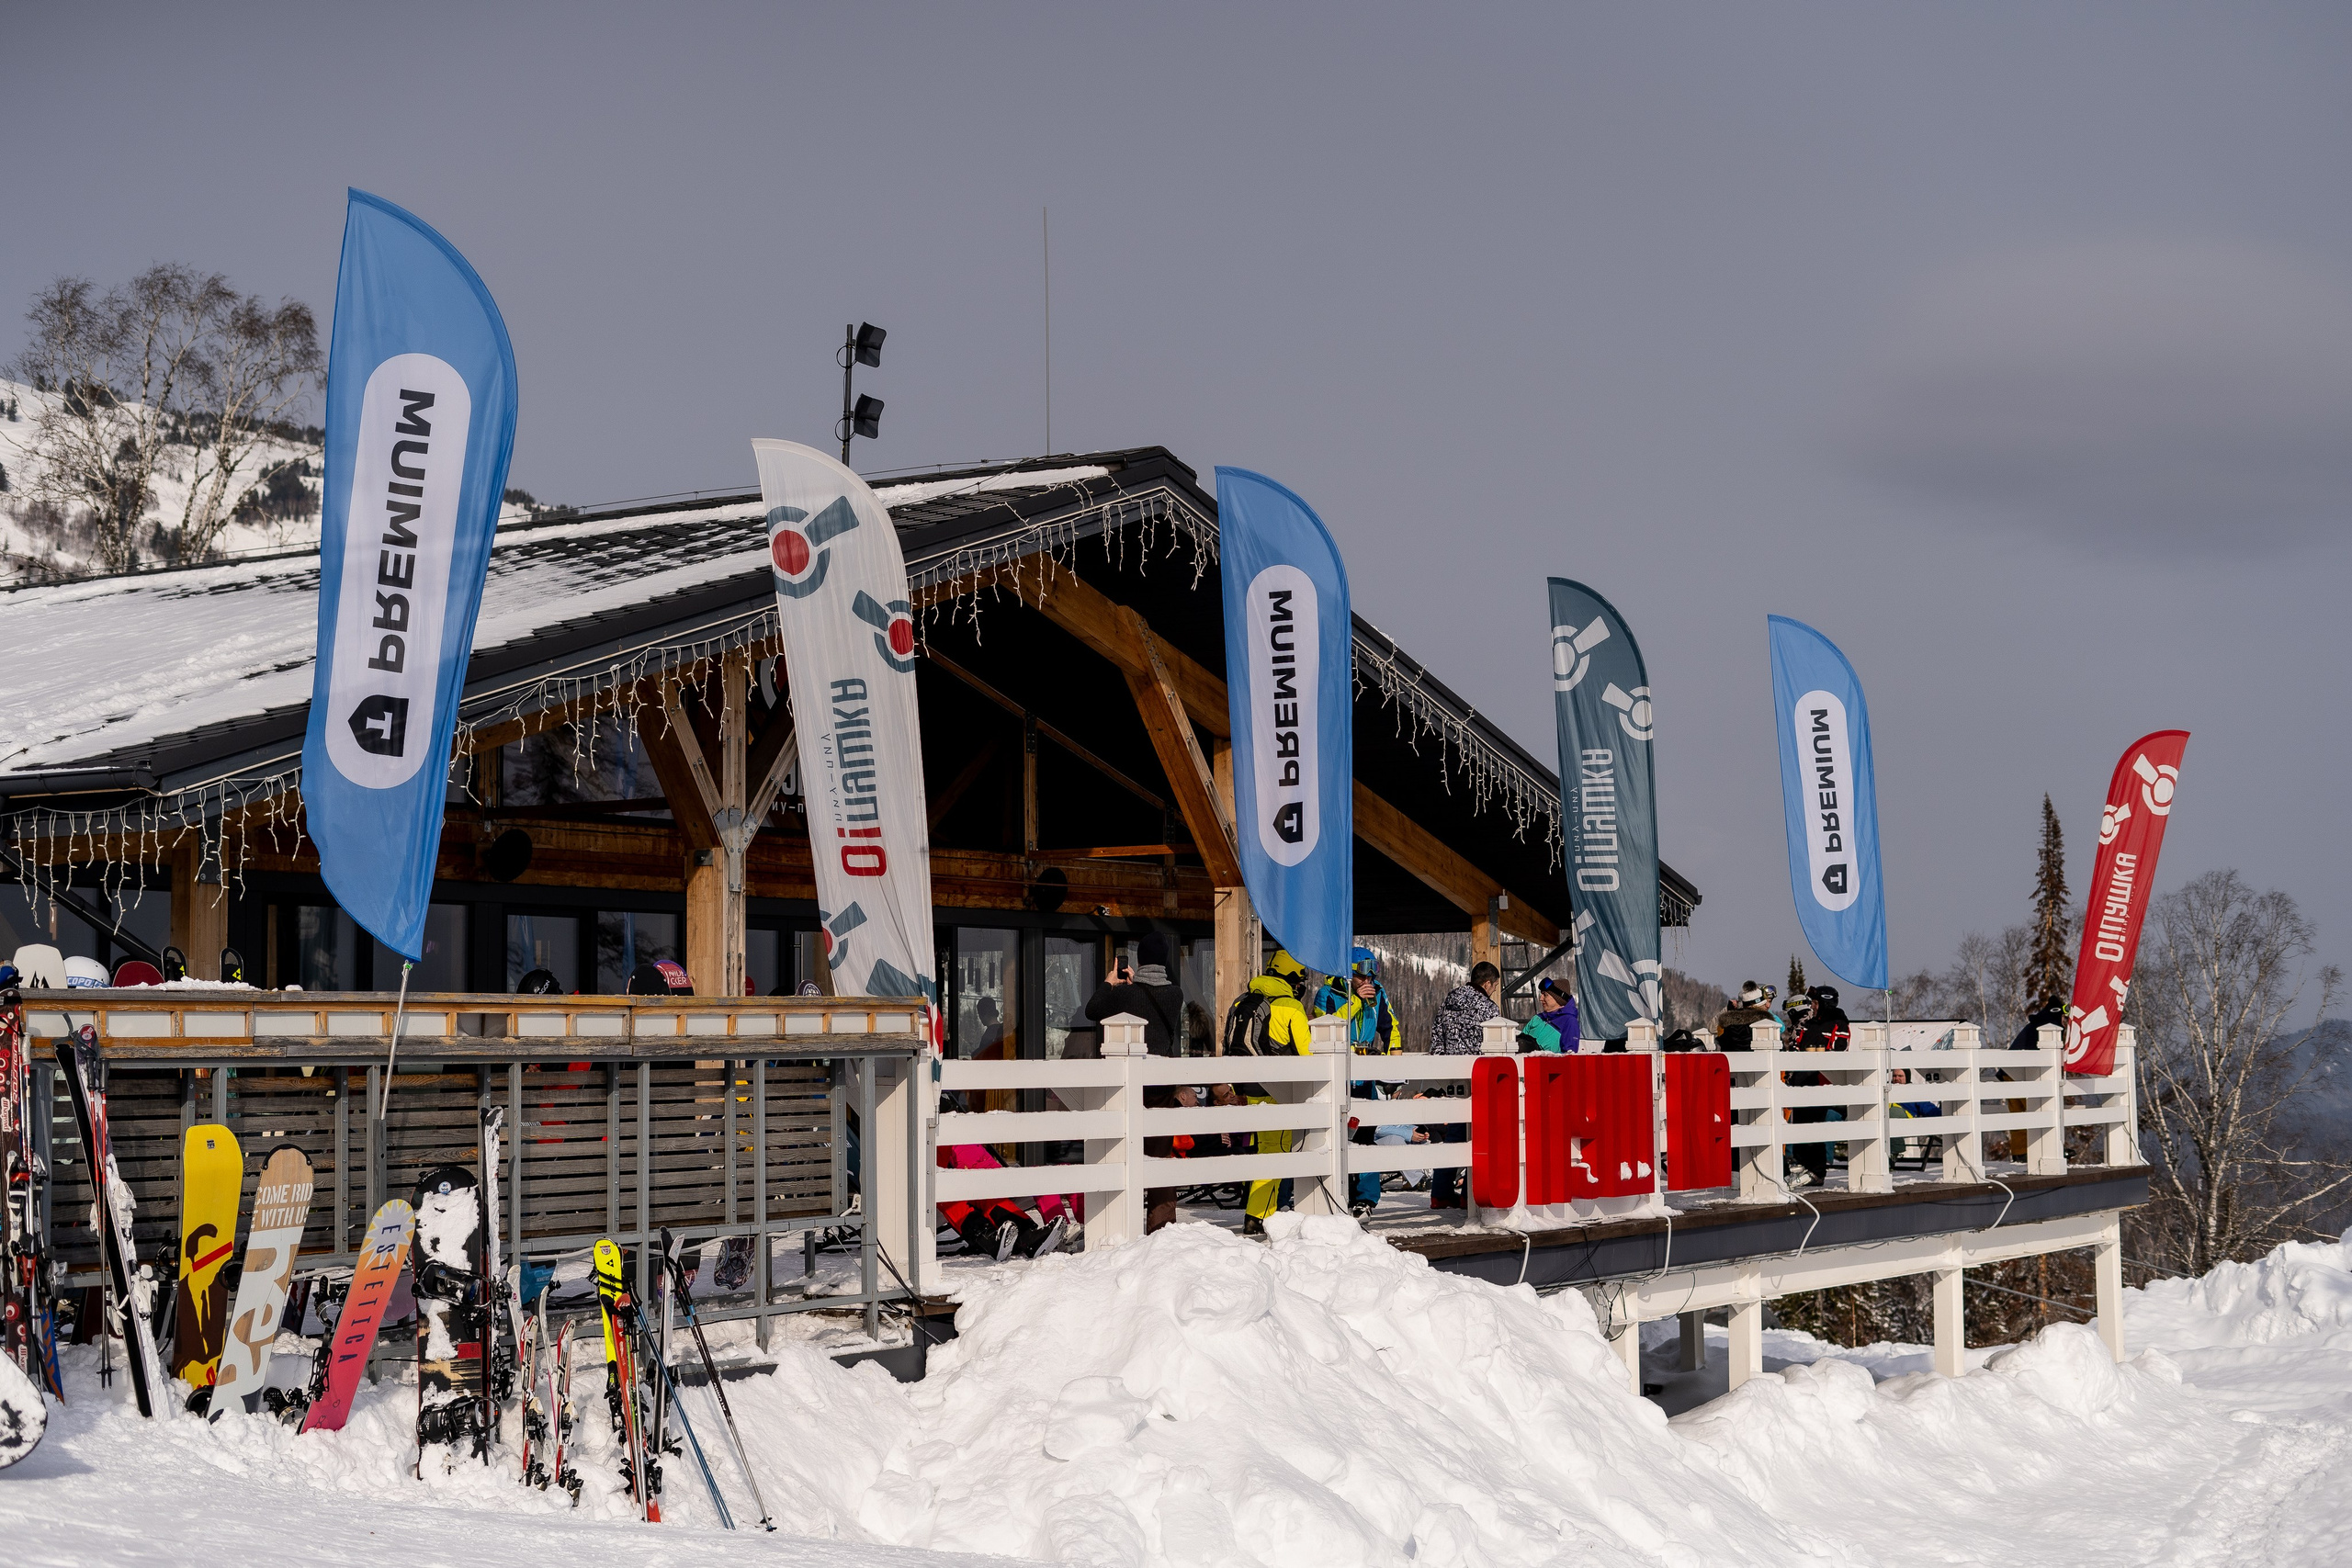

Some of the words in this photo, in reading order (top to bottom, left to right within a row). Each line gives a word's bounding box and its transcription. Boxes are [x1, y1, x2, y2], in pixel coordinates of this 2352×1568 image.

[254, 1185, 290, 1205] COME
[261, 1207, 295, 1227] WITH
[338, 1224, 401, 1363] ESTETICA
